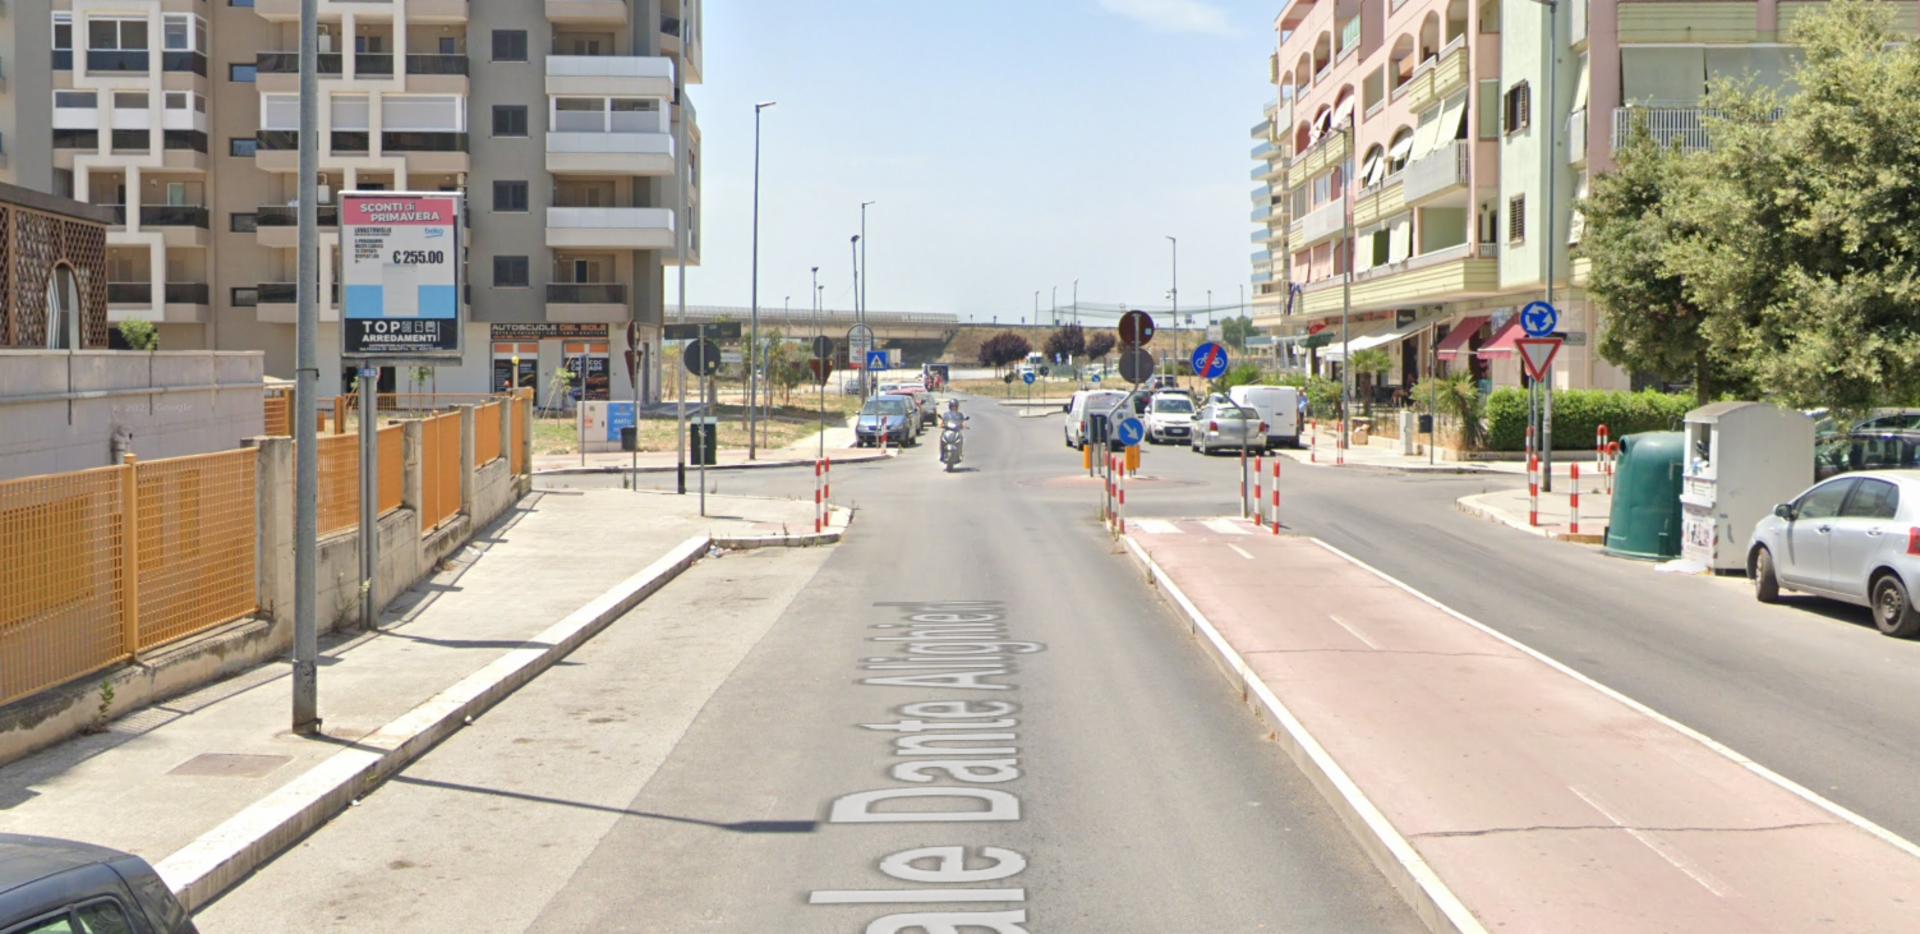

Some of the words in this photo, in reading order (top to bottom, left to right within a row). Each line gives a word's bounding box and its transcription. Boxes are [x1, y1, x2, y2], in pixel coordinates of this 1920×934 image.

[360, 202, 402, 213] SCONTI
[404, 202, 415, 212] di
[371, 212, 440, 222] PRIMAVERA
[393, 250, 401, 264] €
[402, 250, 444, 264] 255.00
[362, 321, 401, 334] TOP
[362, 334, 437, 343] ARREDAMENTI
